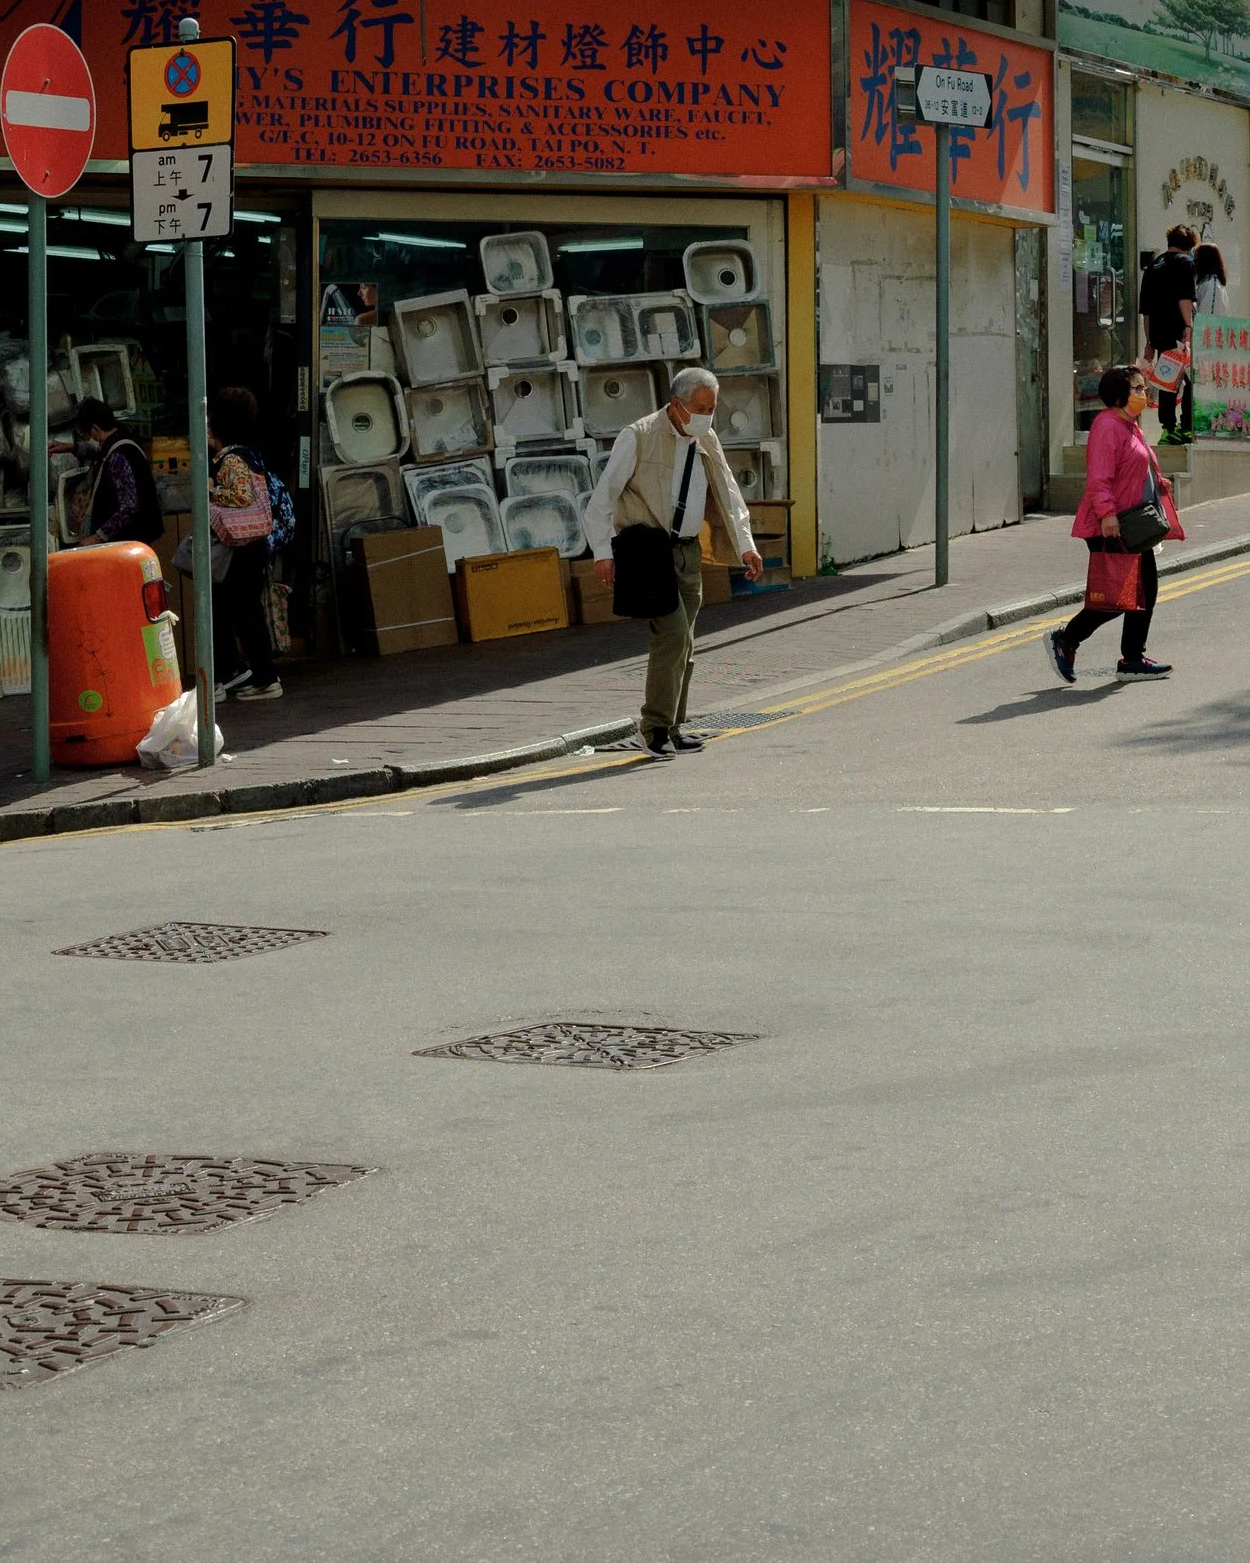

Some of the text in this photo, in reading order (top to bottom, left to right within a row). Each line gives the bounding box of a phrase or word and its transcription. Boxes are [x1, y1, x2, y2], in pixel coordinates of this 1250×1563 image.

[435, 14, 788, 76] 建材燈飾中心
[329, 69, 585, 102] ENTERPRISES
[603, 79, 786, 107] COMPANY
[935, 74, 974, 92] On Fu Road
[252, 94, 379, 113] MATERIALS
[384, 98, 493, 118] SUPPLIES,
[498, 102, 608, 120] SANITARY
[613, 107, 681, 123] WARE,
[687, 109, 772, 126] FAUCET,
[941, 99, 969, 118] 安富道
[300, 114, 415, 131] PLUMBING
[424, 118, 512, 135] FITTING
[520, 121, 534, 135] &
[544, 122, 688, 139] ACCESSORIES
[695, 128, 726, 140] etc.
[326, 131, 377, 147] 10-12
[382, 133, 415, 148] ON
[421, 135, 449, 149] FU
[453, 136, 522, 152] ROAD,
[530, 138, 563, 153] TAI
[570, 140, 605, 155] PO,
[158, 154, 213, 183] am 7
[291, 147, 626, 170] TEL: 2653-6356 FAX: 2653-5082
[154, 170, 182, 187] 上午
[154, 219, 182, 236] 下午
[158, 202, 212, 232] pm 7
